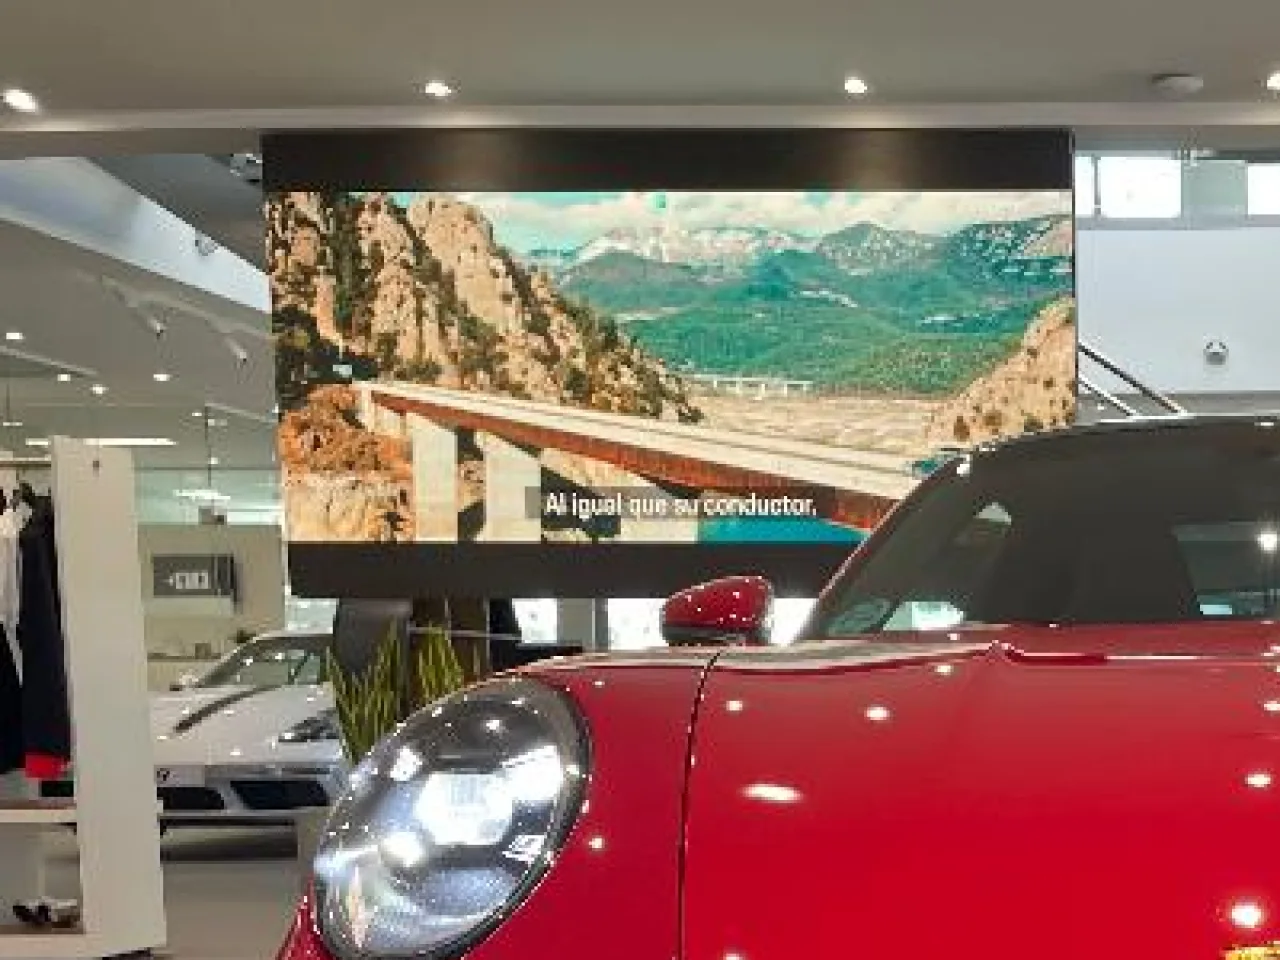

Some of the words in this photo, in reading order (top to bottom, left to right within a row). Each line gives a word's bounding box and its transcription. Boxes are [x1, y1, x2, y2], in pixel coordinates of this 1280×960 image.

[545, 492, 566, 515] Al
[572, 492, 622, 520] igual
[629, 497, 668, 520] que
[674, 497, 698, 515] su
[703, 492, 817, 516] conductor.
